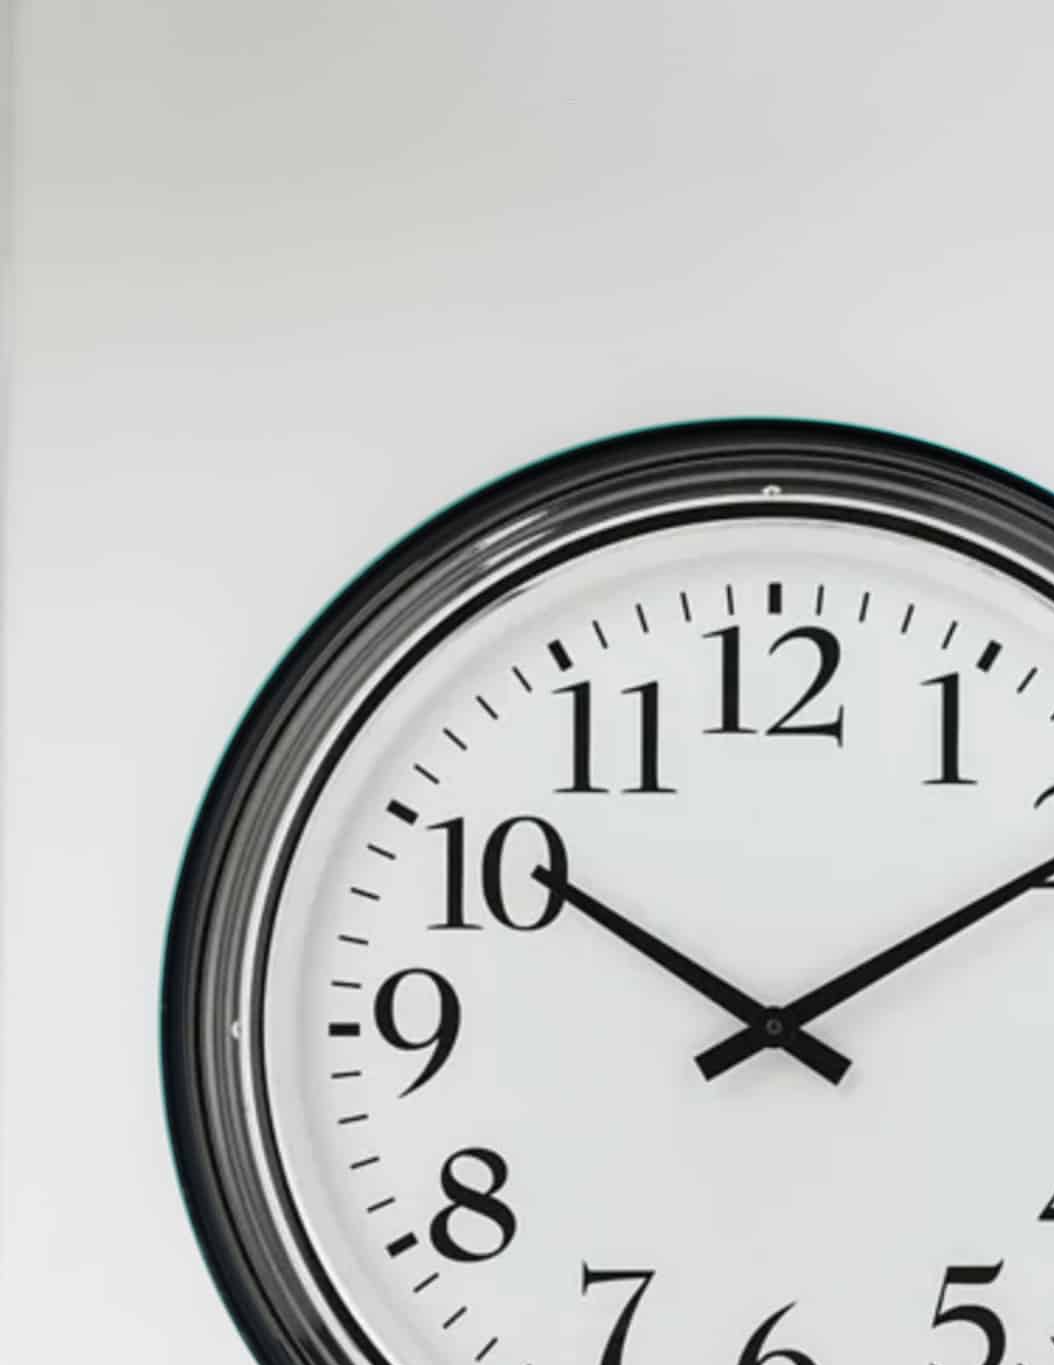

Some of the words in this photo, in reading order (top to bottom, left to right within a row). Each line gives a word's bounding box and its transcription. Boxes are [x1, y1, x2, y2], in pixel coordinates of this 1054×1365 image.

[552, 680, 680, 794] 11
[702, 626, 846, 746] 12
[920, 672, 979, 785] 1
[425, 816, 569, 931] 10
[373, 967, 462, 1099] 9
[428, 1147, 518, 1263] 8
